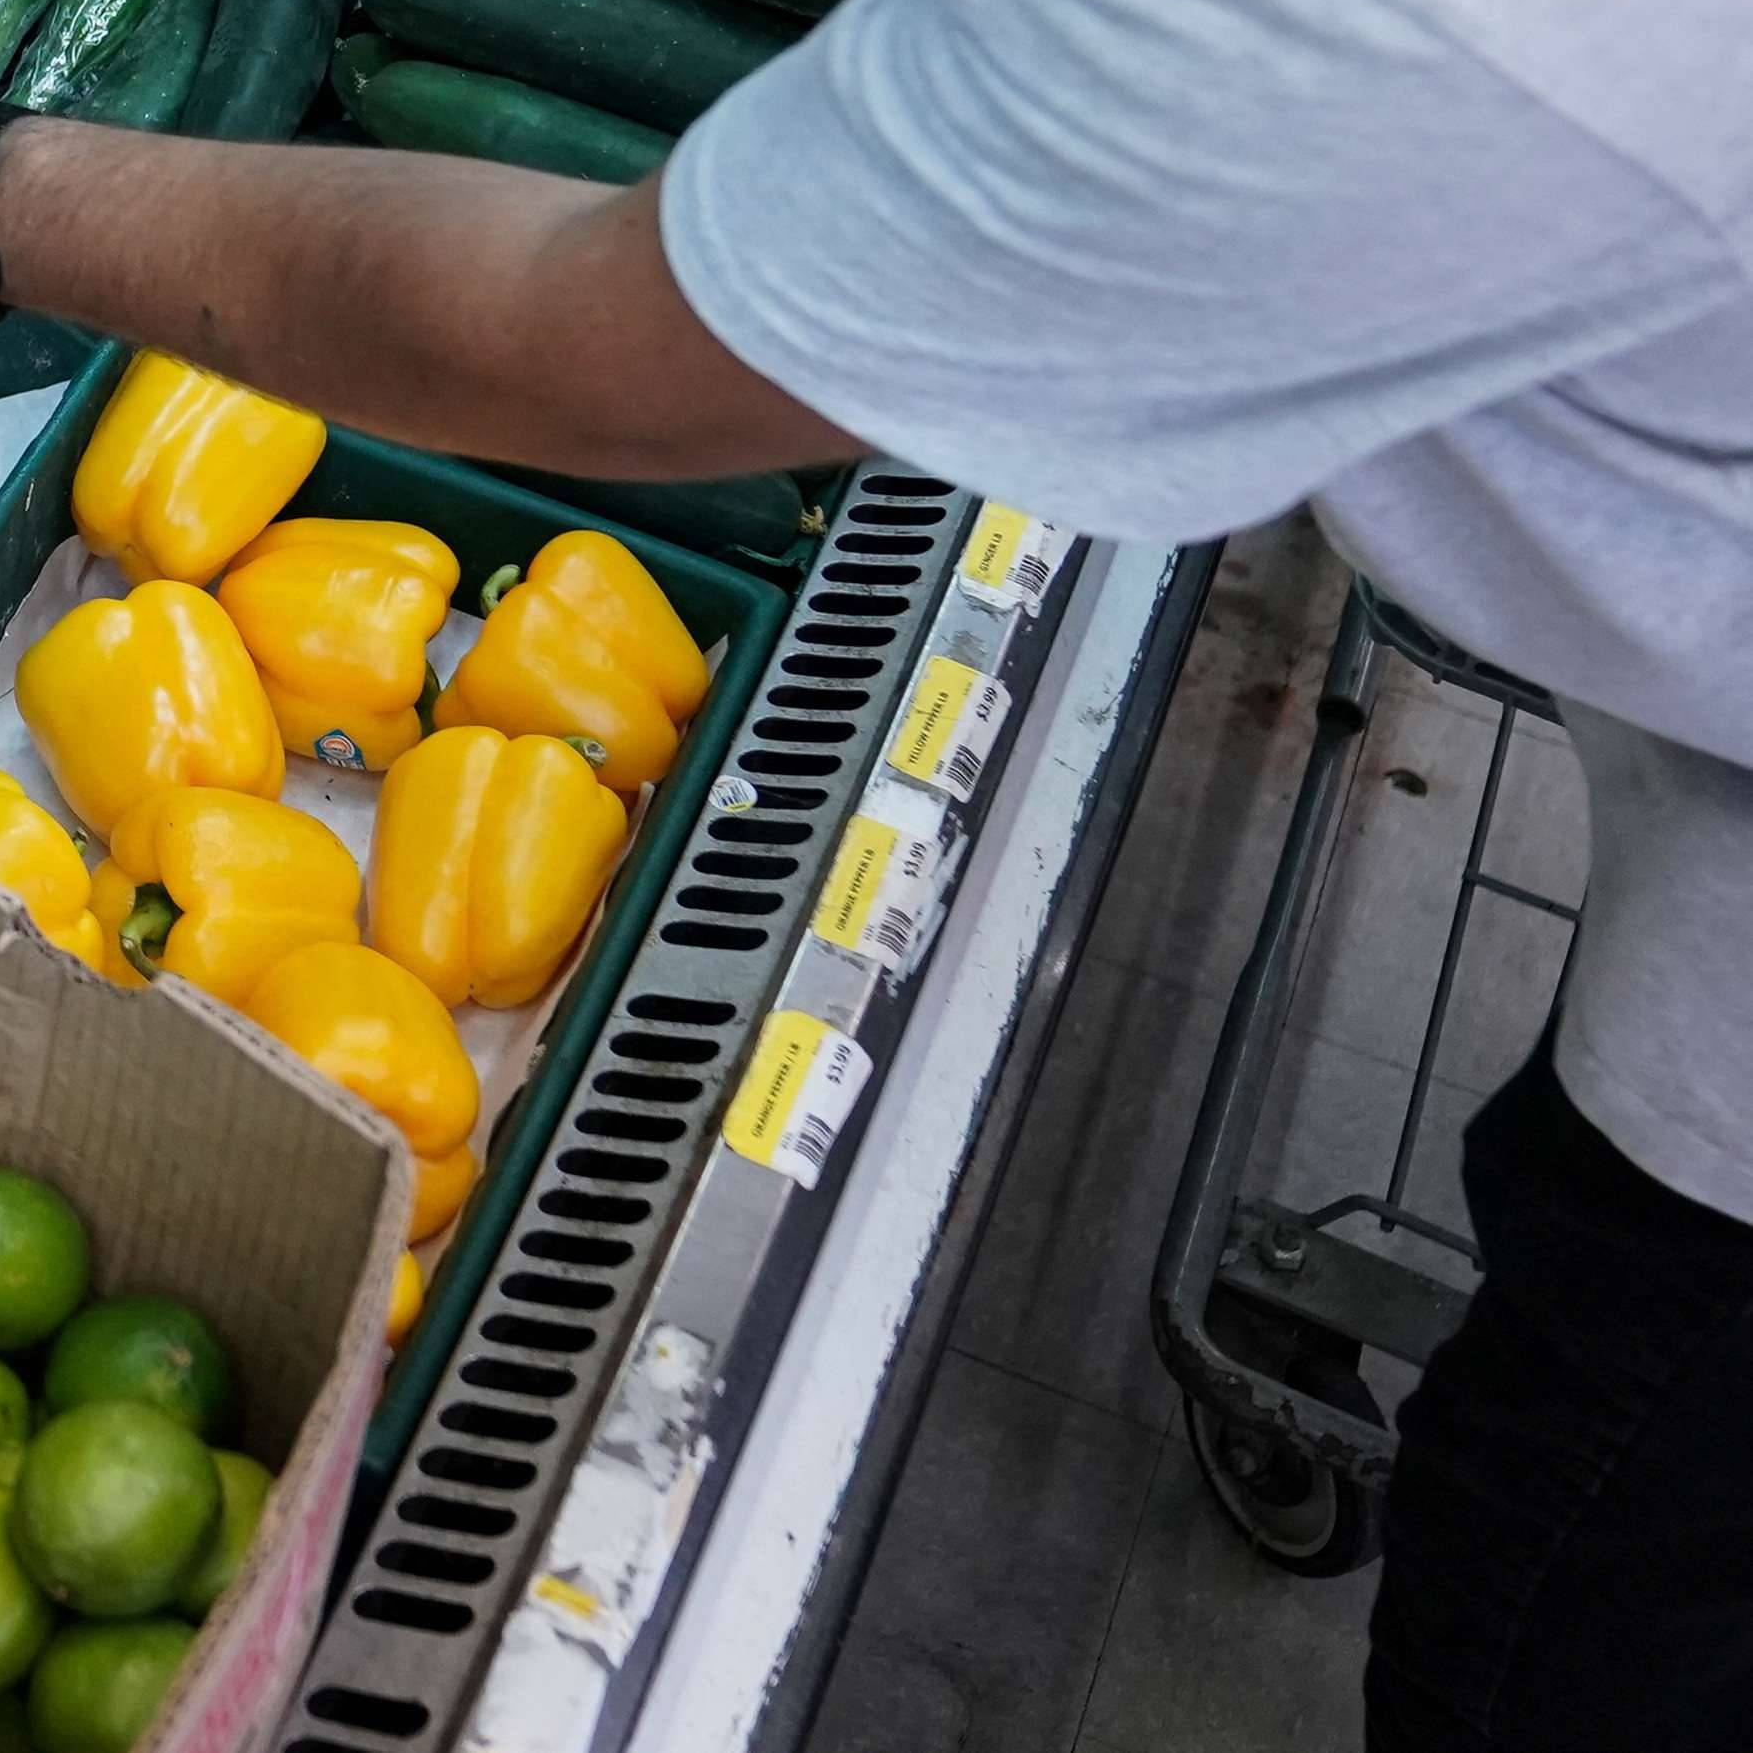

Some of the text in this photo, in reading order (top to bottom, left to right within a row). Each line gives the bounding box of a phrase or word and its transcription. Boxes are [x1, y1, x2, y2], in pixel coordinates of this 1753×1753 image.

[978, 531, 1003, 571] GINGER LB
[974, 686, 999, 722] $3.99
[908, 691, 949, 765] YELLOW PEPPER LB
[902, 840, 927, 878] $3.99
[834, 847, 875, 931] ORANGE PEPPER LB
[824, 1043, 852, 1083] $3.99
[750, 1097, 776, 1138] ORANGE
[768, 1062, 791, 1097] PEPPER
[788, 1042, 801, 1055] LB
